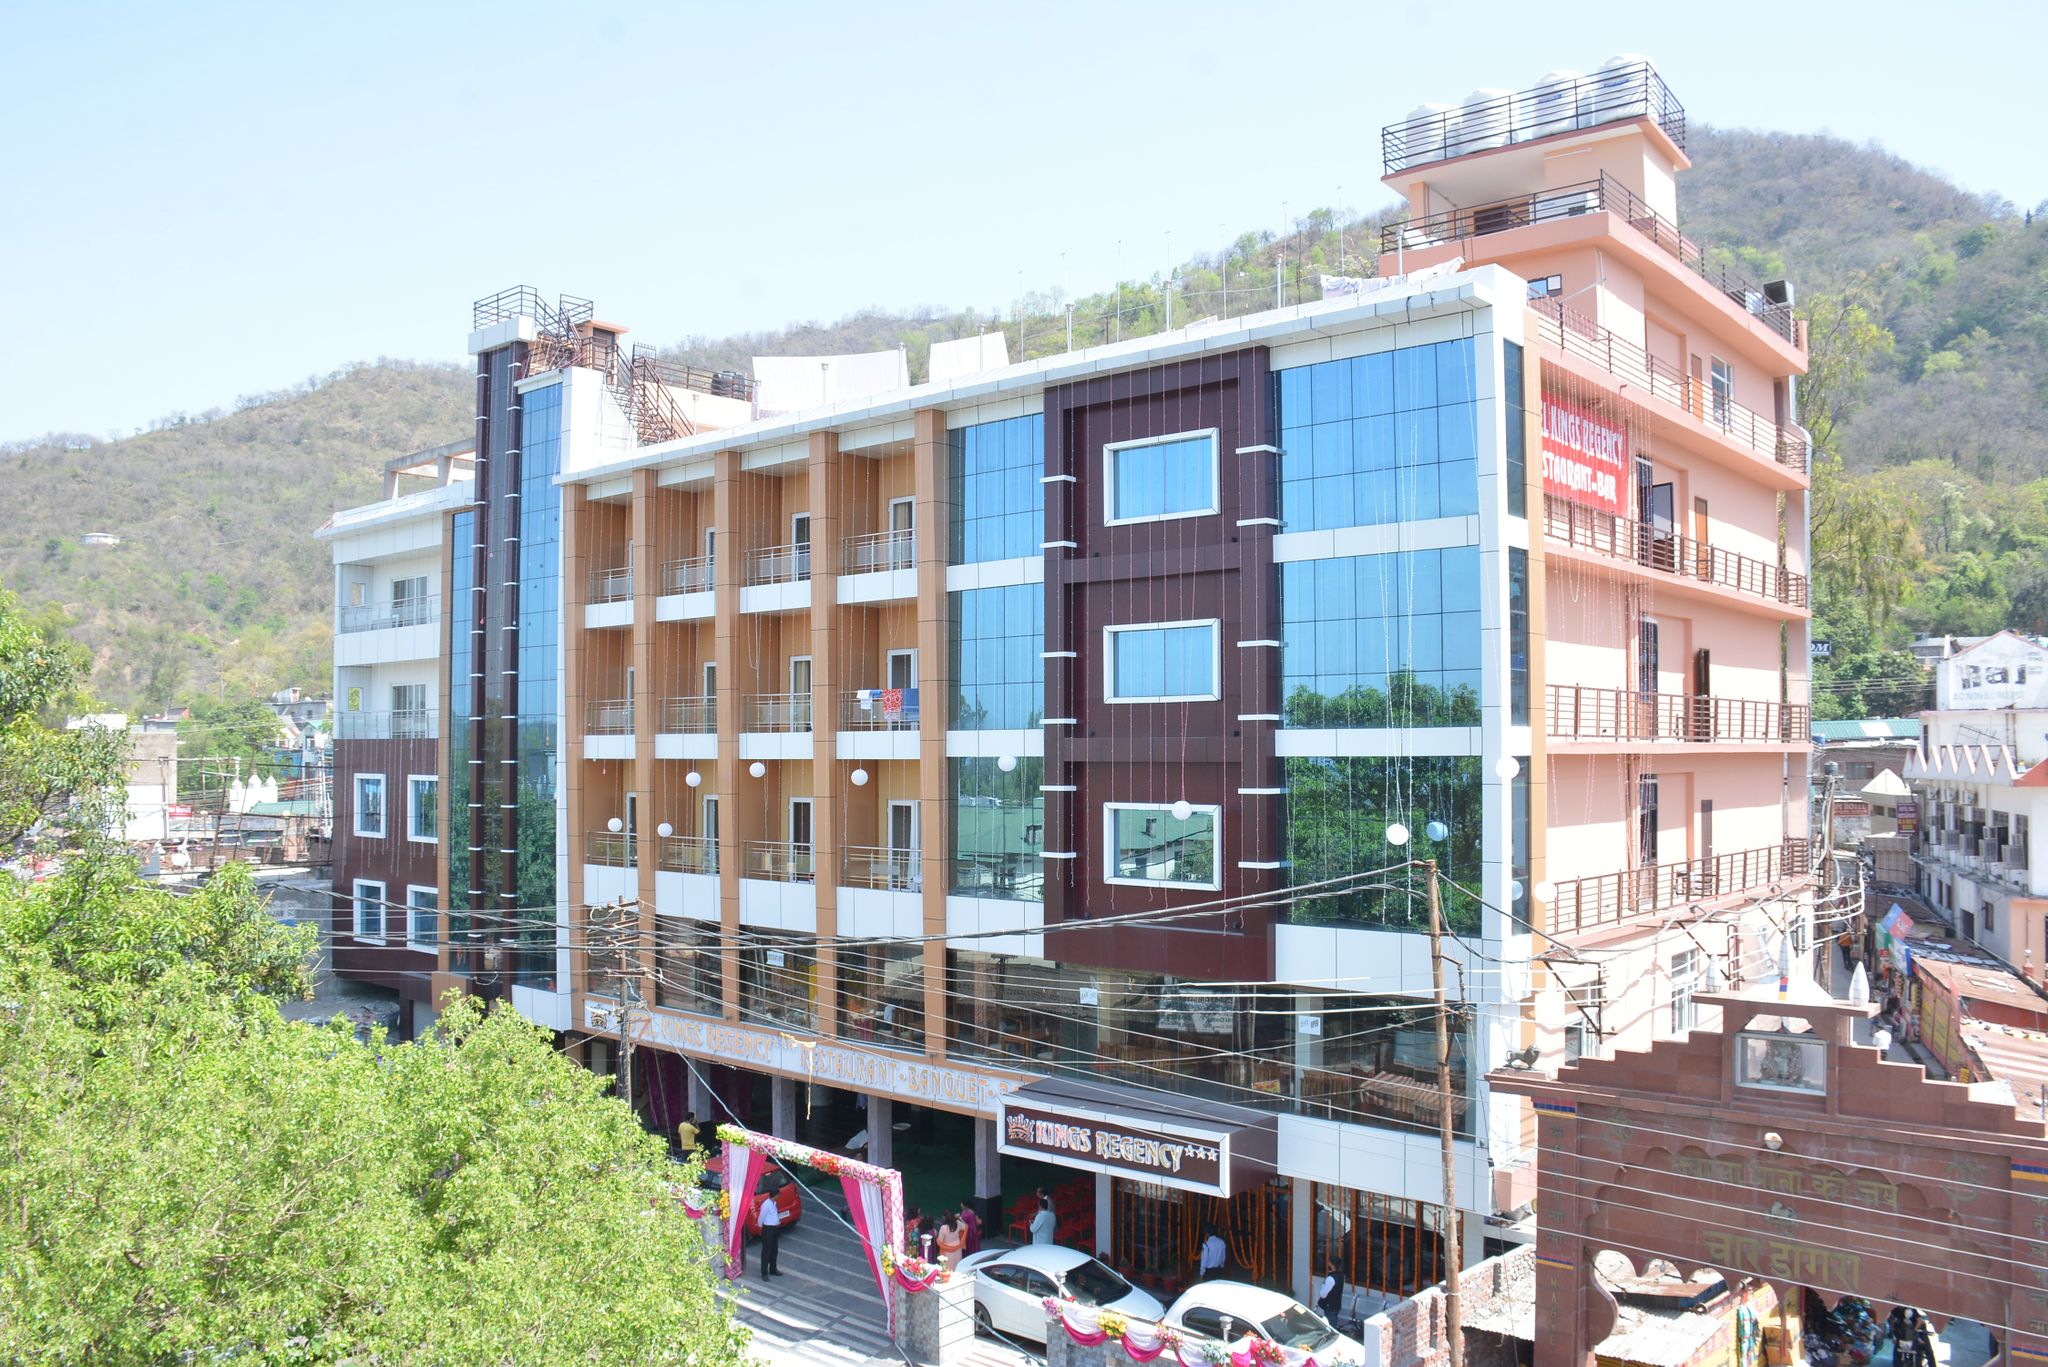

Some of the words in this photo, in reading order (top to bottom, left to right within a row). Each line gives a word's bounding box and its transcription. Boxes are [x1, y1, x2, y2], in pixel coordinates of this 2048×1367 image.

[1551, 405, 1581, 450] KINGS
[1582, 419, 1624, 470] REGENCY
[660, 1017, 704, 1047] KINGS
[705, 1025, 772, 1061] REGENCY
[800, 1048, 899, 1088] RESTAURANT
[907, 1065, 990, 1105] BANQUET
[1035, 1119, 1092, 1152] KINGS
[1095, 1131, 1185, 1173] REGENCY
